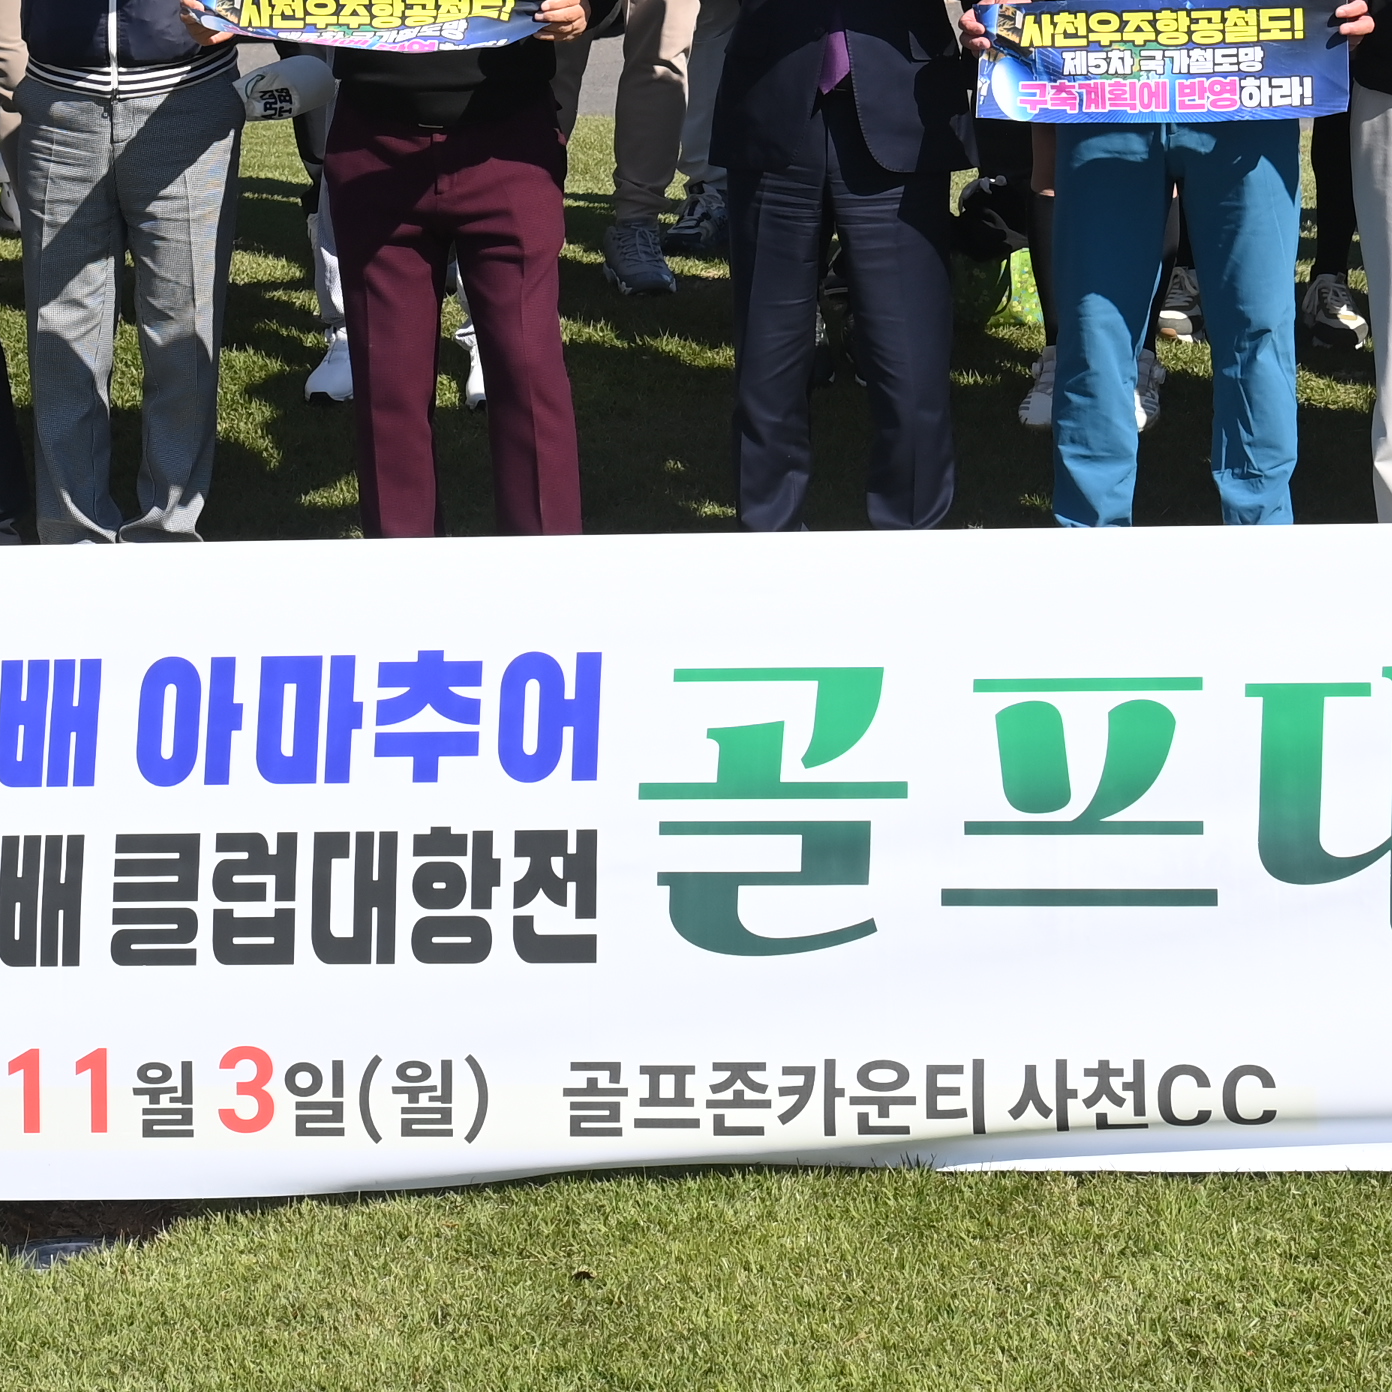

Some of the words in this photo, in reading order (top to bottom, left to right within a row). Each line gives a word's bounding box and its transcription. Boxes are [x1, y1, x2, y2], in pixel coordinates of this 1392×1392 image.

[1020, 8, 1303, 48] 사천우주항공철도!
[1062, 50, 1132, 76] 제5차
[1139, 47, 1264, 73] 국가철도망
[1018, 80, 1168, 111] 구축계획에
[135, 649, 604, 786] 아마추어
[109, 820, 600, 967] 클럽대항전
[561, 1059, 986, 1140] 골프존카운티
[1006, 1058, 1281, 1135] 사천CC
